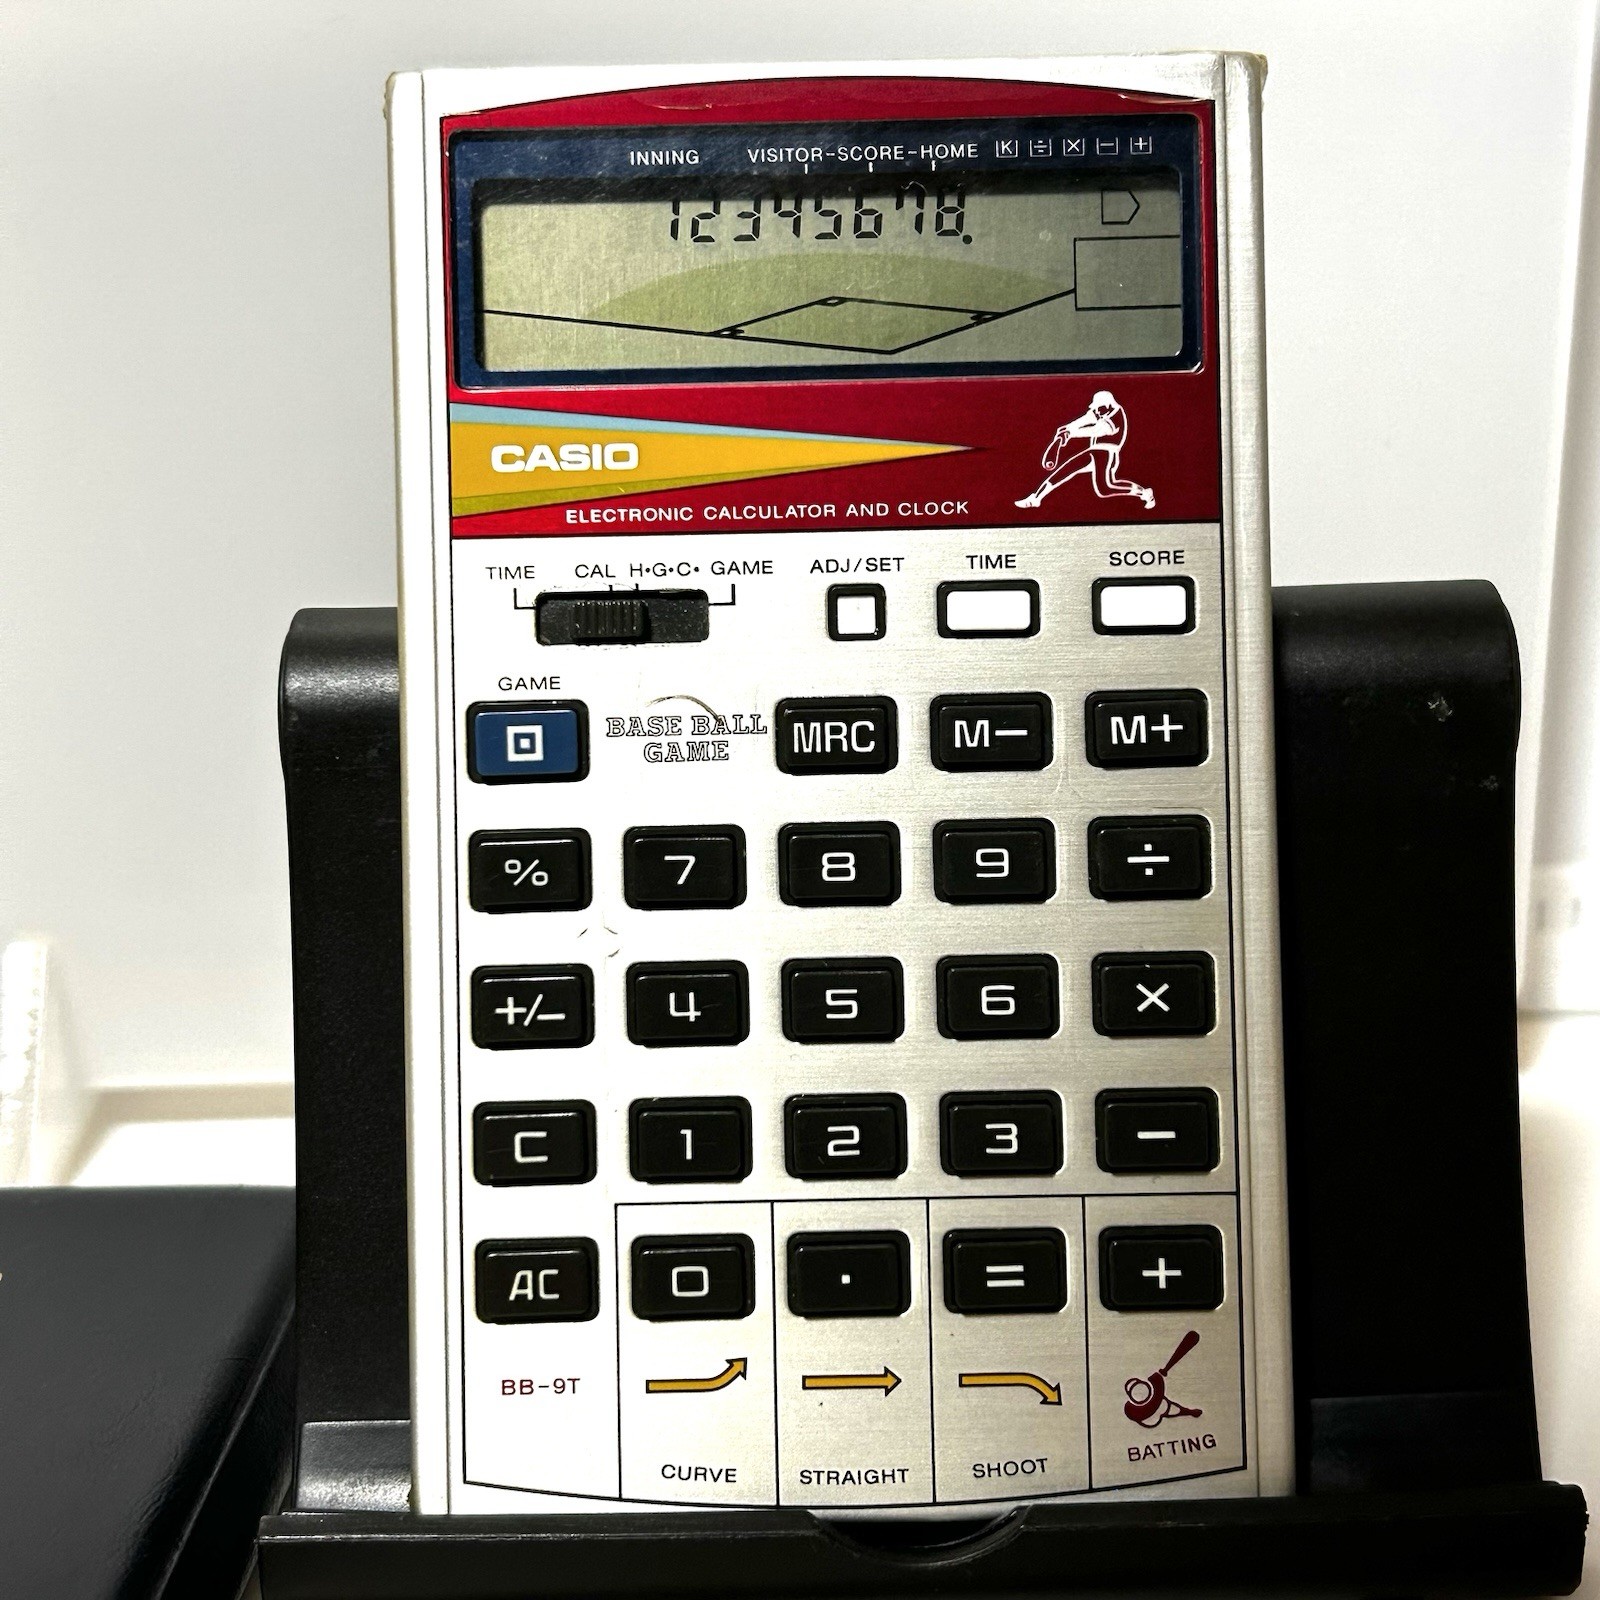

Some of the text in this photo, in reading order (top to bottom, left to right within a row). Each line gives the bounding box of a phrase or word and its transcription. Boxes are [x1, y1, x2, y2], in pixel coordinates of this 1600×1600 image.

[630, 150, 699, 165] INNING
[1001, 140, 1013, 155] K
[492, 443, 638, 472] CASIO
[566, 502, 968, 523] ELECTRONIC CALCULATOR AND CLOCK
[711, 561, 773, 575] GAME
[810, 558, 904, 573] ADJ/SET
[966, 554, 1016, 569] TIME
[1110, 550, 1184, 566] SCORE
[486, 566, 535, 579] TIME
[575, 565, 615, 578] CAL
[498, 677, 560, 691] GAME
[605, 713, 767, 738] BASE BALL
[794, 721, 875, 752] MRC
[1111, 714, 1183, 744] M+
[643, 742, 730, 763] GAME
[505, 860, 548, 886] %
[664, 856, 695, 884] 7
[822, 852, 855, 881] 8
[976, 849, 1009, 877] 9
[495, 994, 565, 1026] +/-
[670, 992, 701, 1021] 4
[826, 989, 858, 1018] 5
[981, 985, 1015, 1015] 6
[514, 1132, 548, 1163] C
[680, 1129, 692, 1159] 1
[828, 1126, 860, 1156] 2
[986, 1124, 1018, 1153] 3
[509, 1269, 559, 1300] AC
[672, 1266, 709, 1297] 0
[502, 1378, 580, 1395] BB-9T
[1128, 1434, 1216, 1461] BATTING
[662, 1465, 736, 1483] CURVE
[800, 1469, 909, 1485] STRAIGHT
[973, 1458, 1047, 1478] SHOOT
